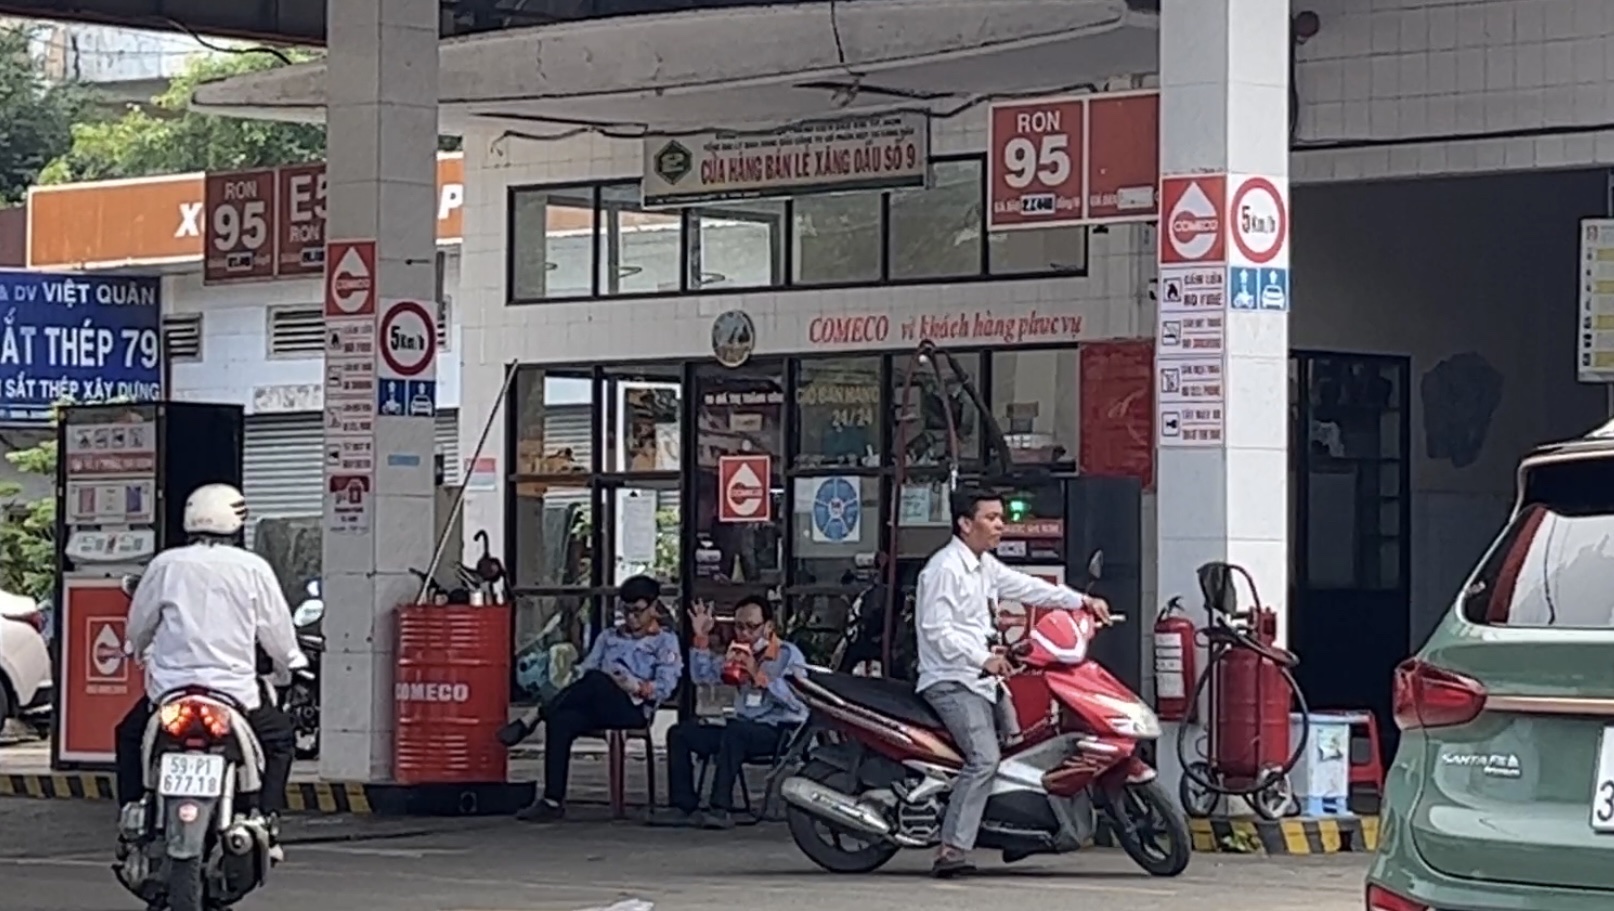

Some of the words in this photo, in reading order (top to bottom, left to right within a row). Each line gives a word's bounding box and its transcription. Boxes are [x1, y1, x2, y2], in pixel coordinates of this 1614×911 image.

[1017, 110, 1060, 133] RON
[905, 143, 916, 170] 9
[1004, 133, 1071, 188] 95
[224, 180, 258, 200] RON
[213, 201, 267, 251] 95
[290, 225, 320, 243] RON
[14, 285, 37, 301] DV
[42, 278, 90, 308] VIỆT
[96, 281, 155, 305] QUÂN
[809, 315, 890, 343] COMECO
[972, 310, 1016, 343] hàng
[44, 317, 114, 367] THÉP
[121, 329, 158, 369] 79
[5, 371, 37, 399] SẮT
[38, 375, 79, 399] THÉP
[82, 377, 114, 400] XÂY
